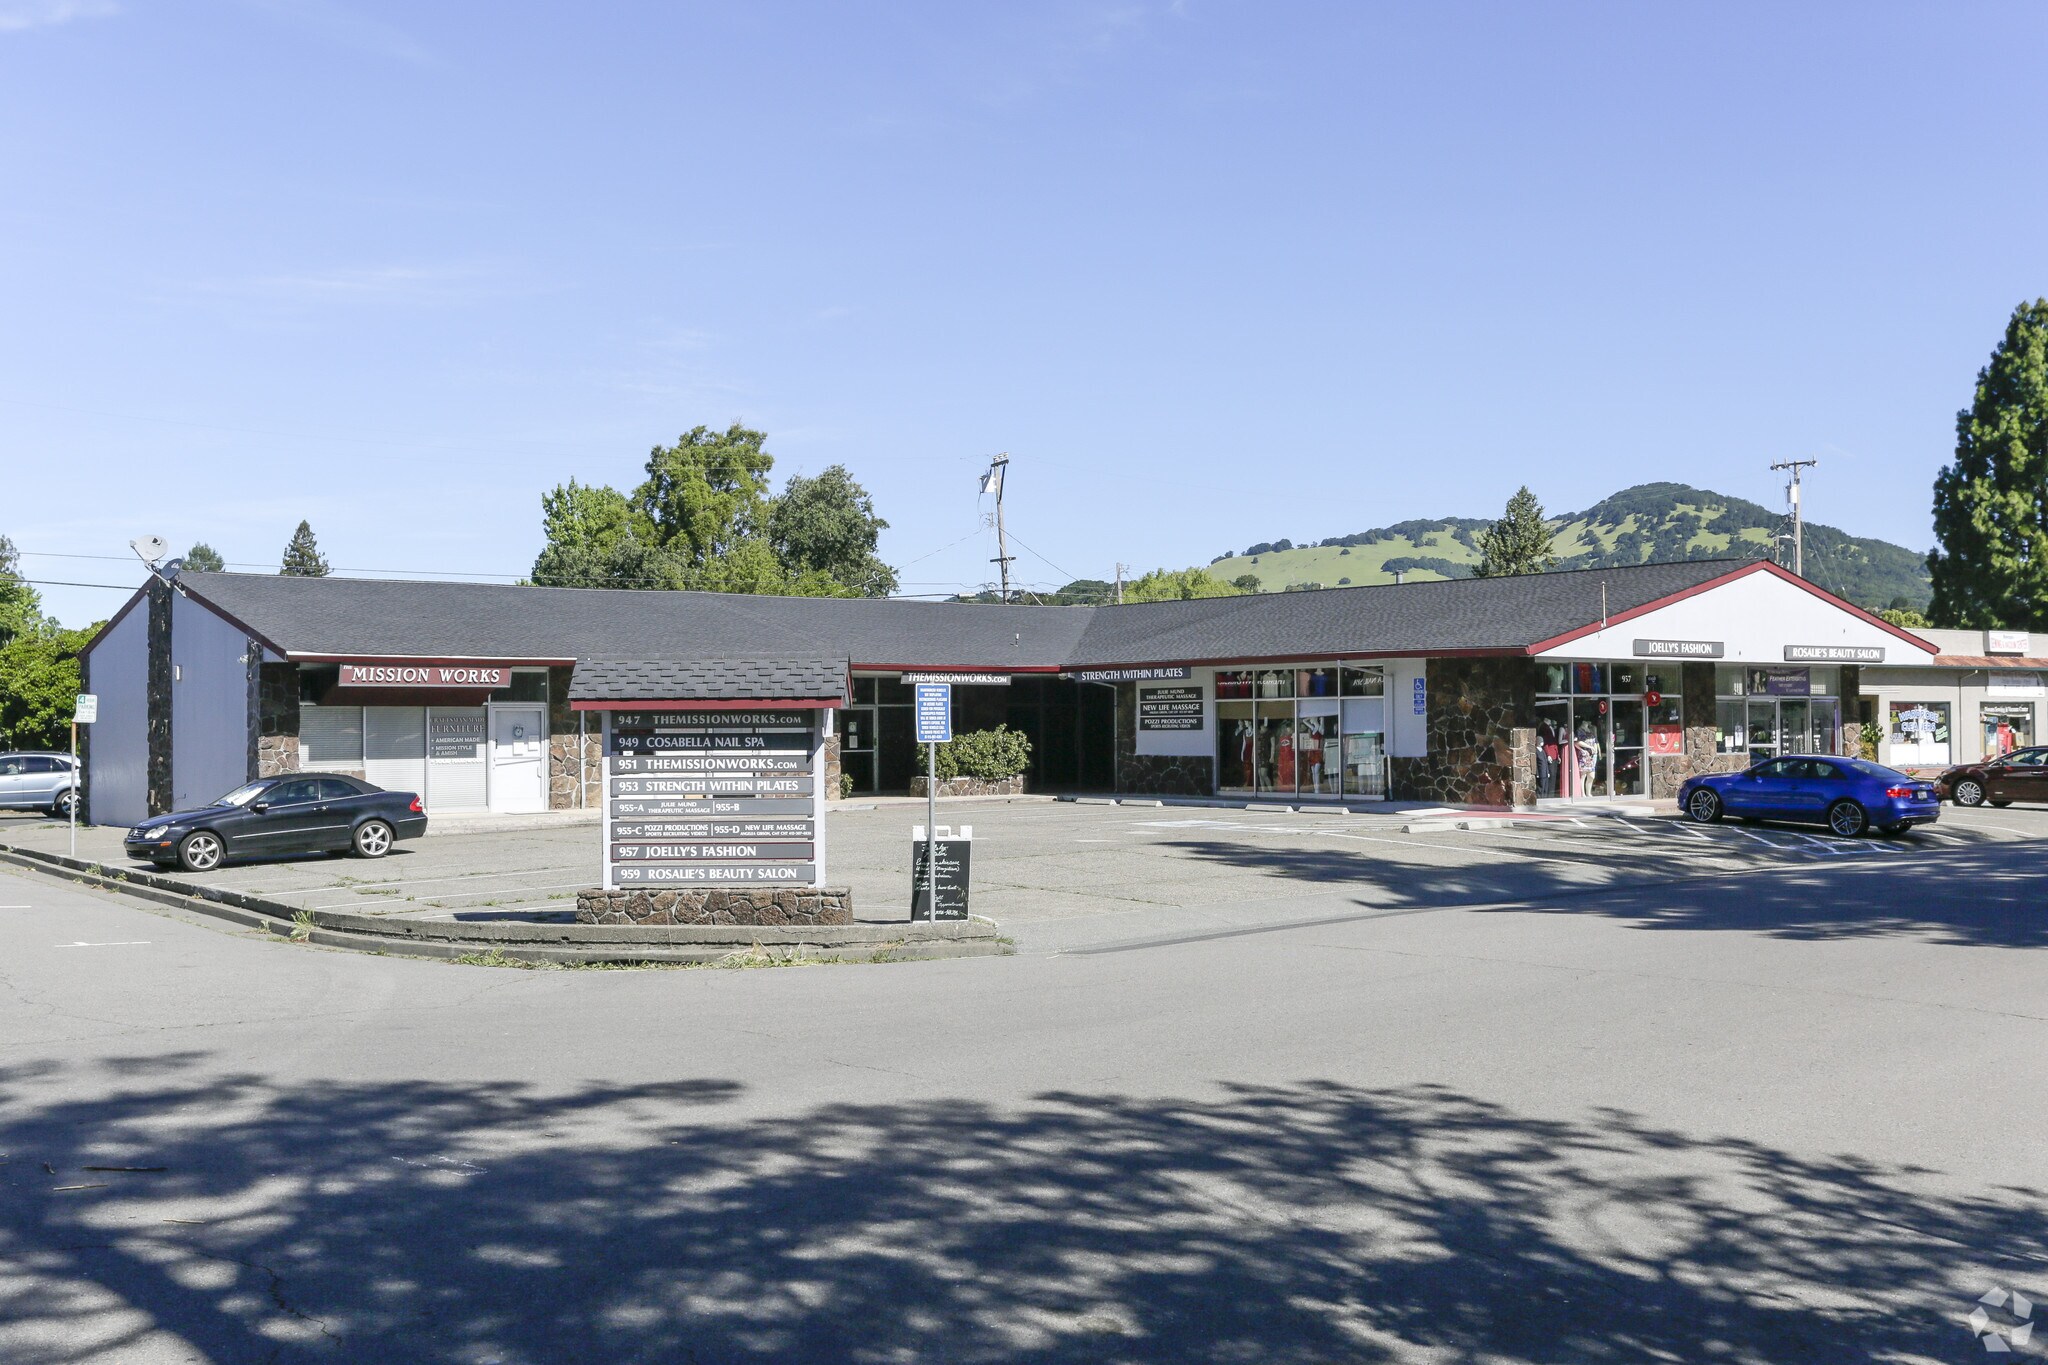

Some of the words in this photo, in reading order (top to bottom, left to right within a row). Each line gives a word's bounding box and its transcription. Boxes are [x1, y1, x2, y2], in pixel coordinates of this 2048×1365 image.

[1649, 641, 1679, 654] JOELLY'S
[1681, 643, 1712, 654] FASHION
[1792, 647, 1827, 658] ROSALIE'S
[1829, 648, 1856, 658] BEAUTY
[1857, 649, 1880, 659] SALON
[352, 667, 430, 683] MISSION
[438, 669, 500, 684] WORKS
[1081, 671, 1120, 681] STRENGTH
[1122, 670, 1152, 679] WITHIN
[1153, 668, 1183, 678] PILATES
[1621, 675, 1632, 683] 957
[1171, 703, 1200, 711] MASSAGE
[618, 715, 641, 725] 947
[618, 737, 639, 747] 949
[646, 737, 711, 748] COSABELLA
[714, 737, 741, 747] NAIL
[744, 737, 765, 747] SPA
[618, 760, 638, 770] 951
[618, 781, 639, 792] 953
[646, 781, 706, 791] STRENGTH
[709, 781, 753, 791] WITHIN
[756, 780, 799, 791] PILATES
[618, 804, 644, 812] 955-A
[715, 803, 740, 811] 955-B
[616, 827, 643, 835] 955-C
[644, 824, 663, 832] POZZI
[714, 825, 741, 834] 955-D
[618, 847, 639, 857] 957
[645, 846, 698, 859] JOELLY'S
[702, 846, 757, 857] FASHION
[620, 870, 641, 880] 959
[648, 868, 706, 880] ROSALIE'S
[709, 869, 754, 879] BEAUTY
[757, 868, 798, 879] SALON
